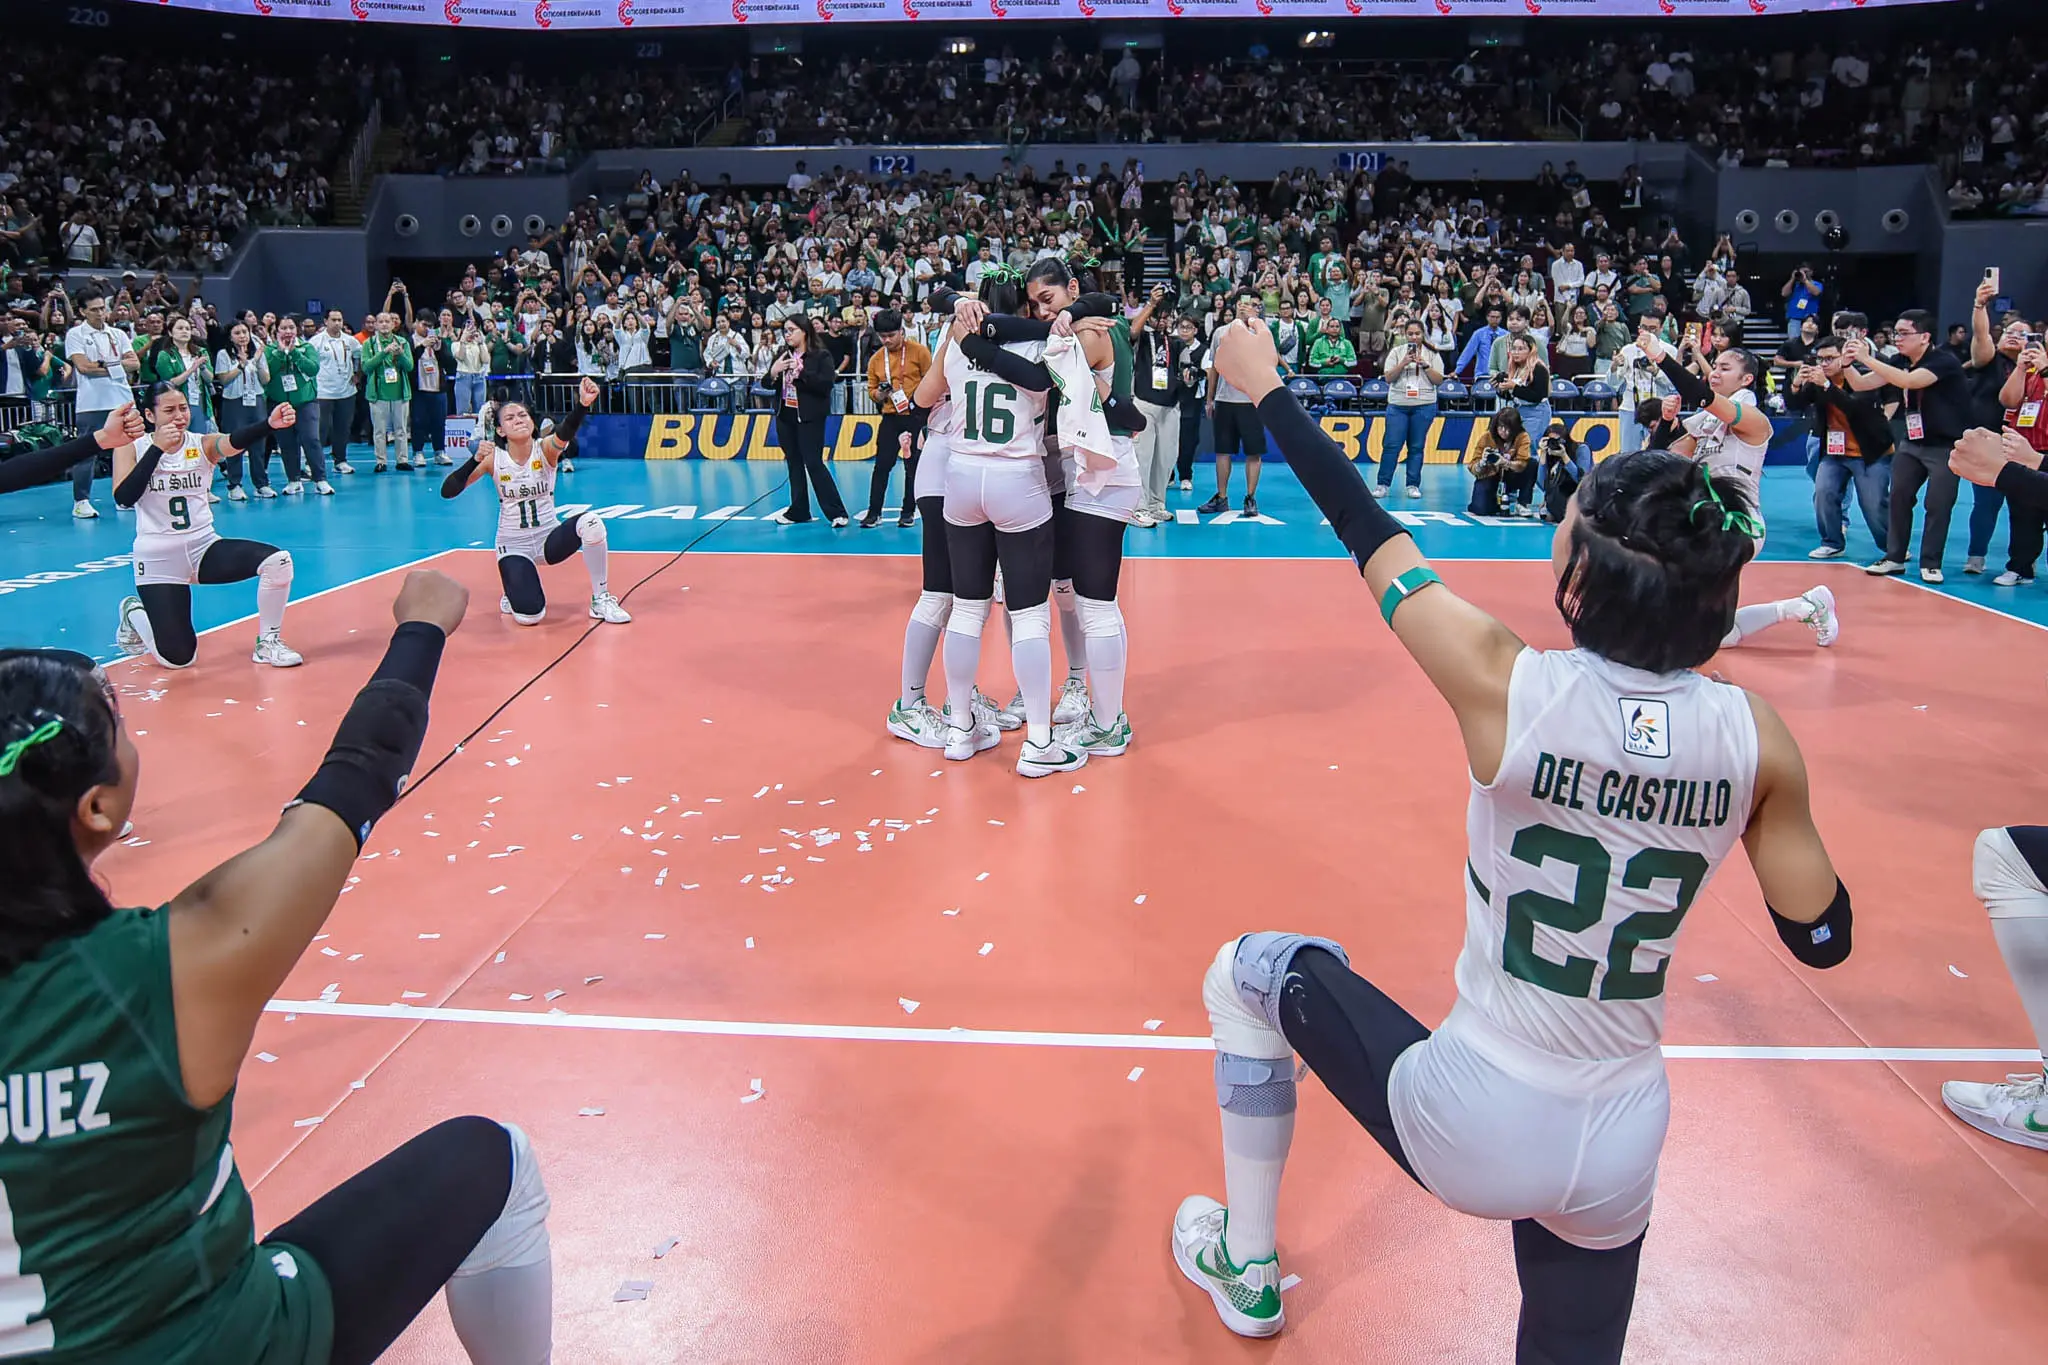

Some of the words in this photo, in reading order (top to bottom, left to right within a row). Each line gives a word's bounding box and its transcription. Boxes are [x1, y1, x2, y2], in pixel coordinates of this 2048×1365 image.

[68, 7, 110, 27] 220
[387, 4, 425, 12] RENEWABLES
[876, 156, 909, 173] 122
[1347, 152, 1378, 171] 101
[964, 381, 1017, 444] 16
[169, 472, 203, 491] Salle
[500, 485, 515, 499] La
[519, 481, 549, 498] Salle
[169, 496, 191, 530] 9
[519, 499, 540, 528] 11
[138, 562, 145, 575] 9
[1531, 751, 1585, 810] DEL
[1596, 769, 1732, 828] CASTILLO
[1503, 823, 1709, 1000] 22
